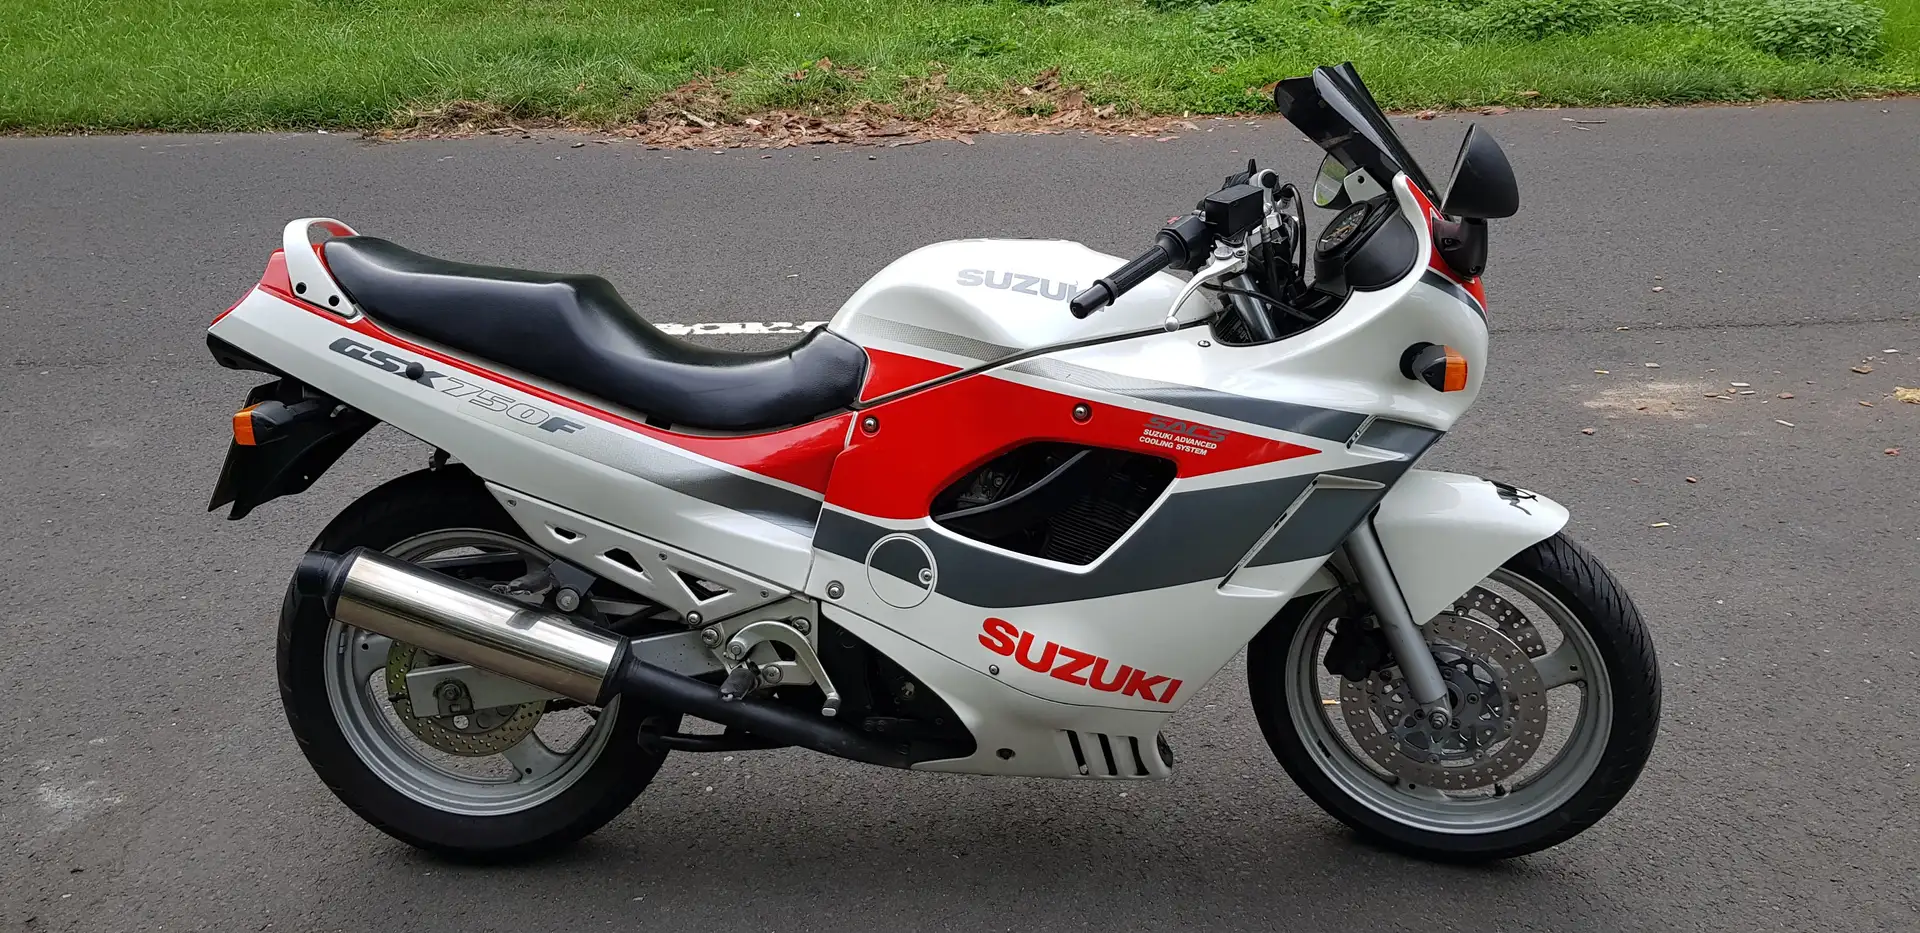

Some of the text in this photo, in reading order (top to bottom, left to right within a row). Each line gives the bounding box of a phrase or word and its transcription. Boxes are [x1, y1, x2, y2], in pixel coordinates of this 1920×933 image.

[956, 269, 1104, 313] SUZU
[1143, 417, 1230, 442] SACS
[1143, 428, 1217, 449] SUZUKI ADVANCED
[1139, 435, 1208, 456] COOLING SYSTEM
[978, 617, 1183, 704] SUZUKI
